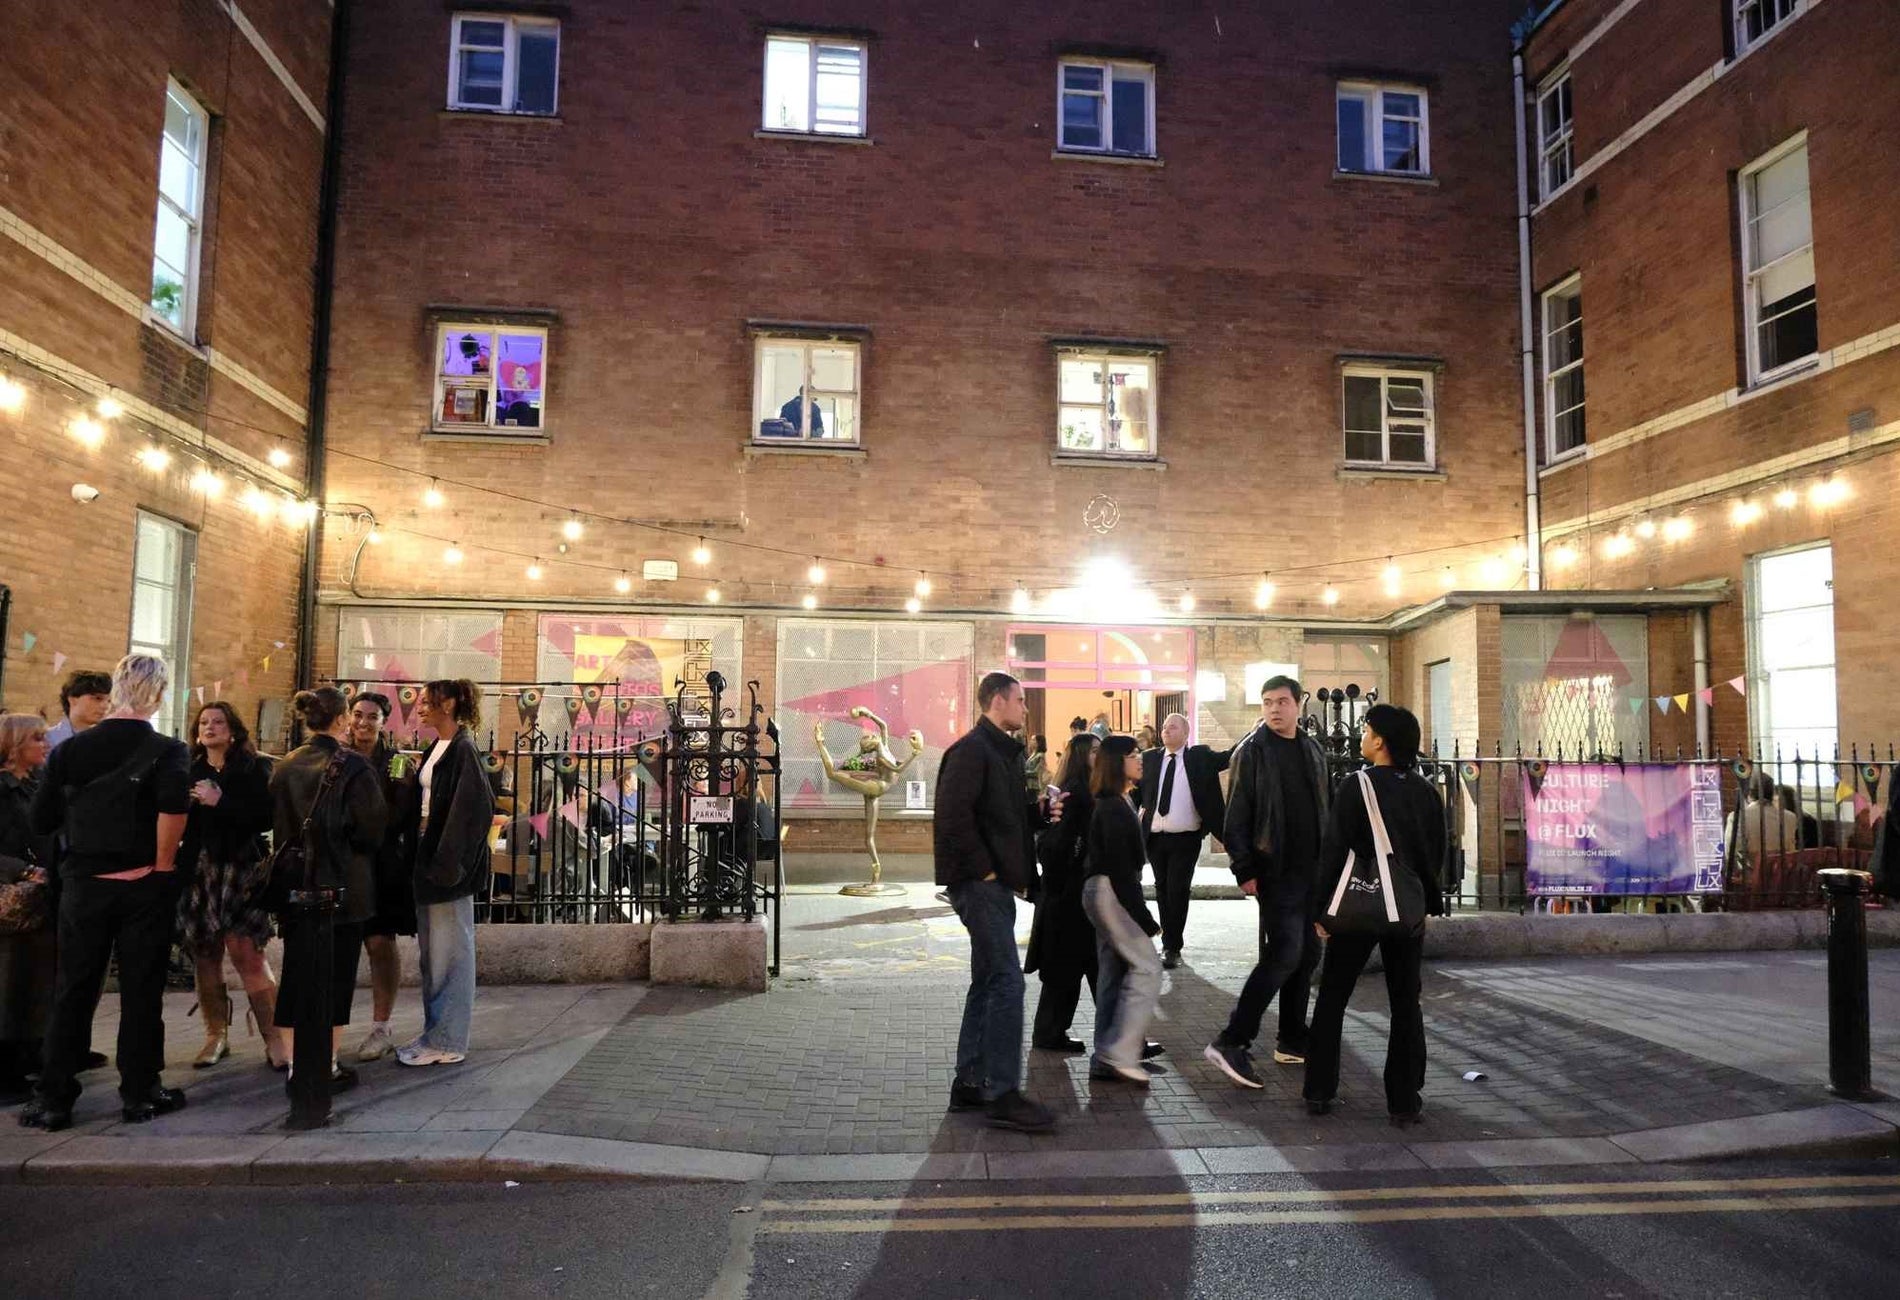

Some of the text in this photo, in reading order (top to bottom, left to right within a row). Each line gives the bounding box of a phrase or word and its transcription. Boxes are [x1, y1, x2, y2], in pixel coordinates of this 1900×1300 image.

[574, 655, 612, 669] ART
[1541, 773, 1610, 788] CULTURE
[706, 801, 717, 809] NO
[1537, 799, 1592, 814] NIGHT
[695, 811, 729, 819] PARKING
[1538, 823, 1598, 840] @ FLUX
